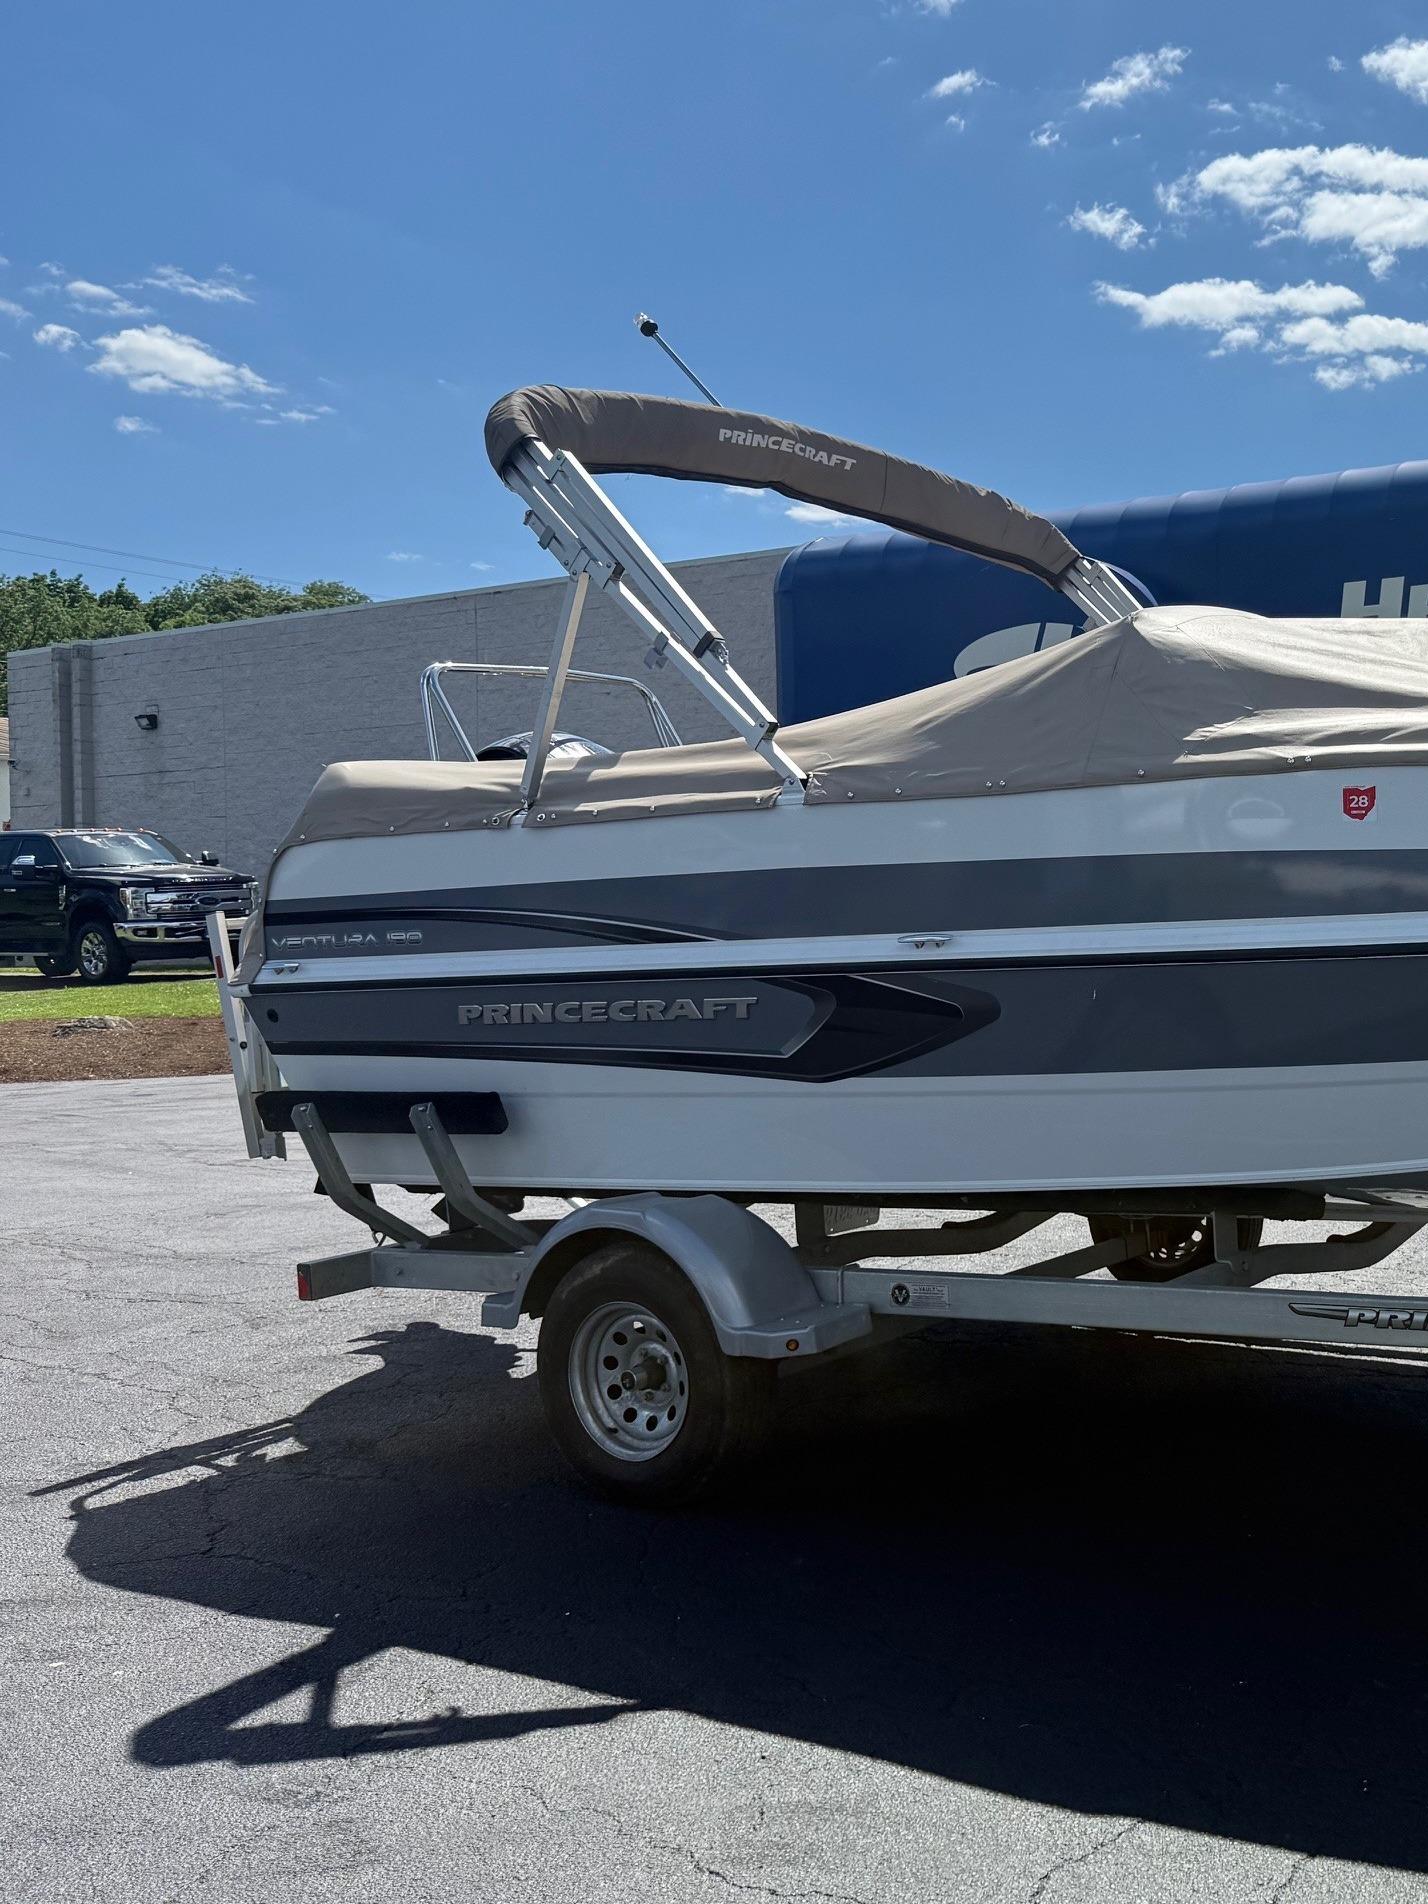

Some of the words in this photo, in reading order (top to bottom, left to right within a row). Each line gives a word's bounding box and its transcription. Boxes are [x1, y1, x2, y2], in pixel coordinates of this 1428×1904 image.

[719, 427, 857, 472] PRINCECRAFT
[1349, 795, 1369, 808] 28
[271, 933, 378, 950] VENTURA
[457, 997, 758, 1026] PRINCECRAFT
